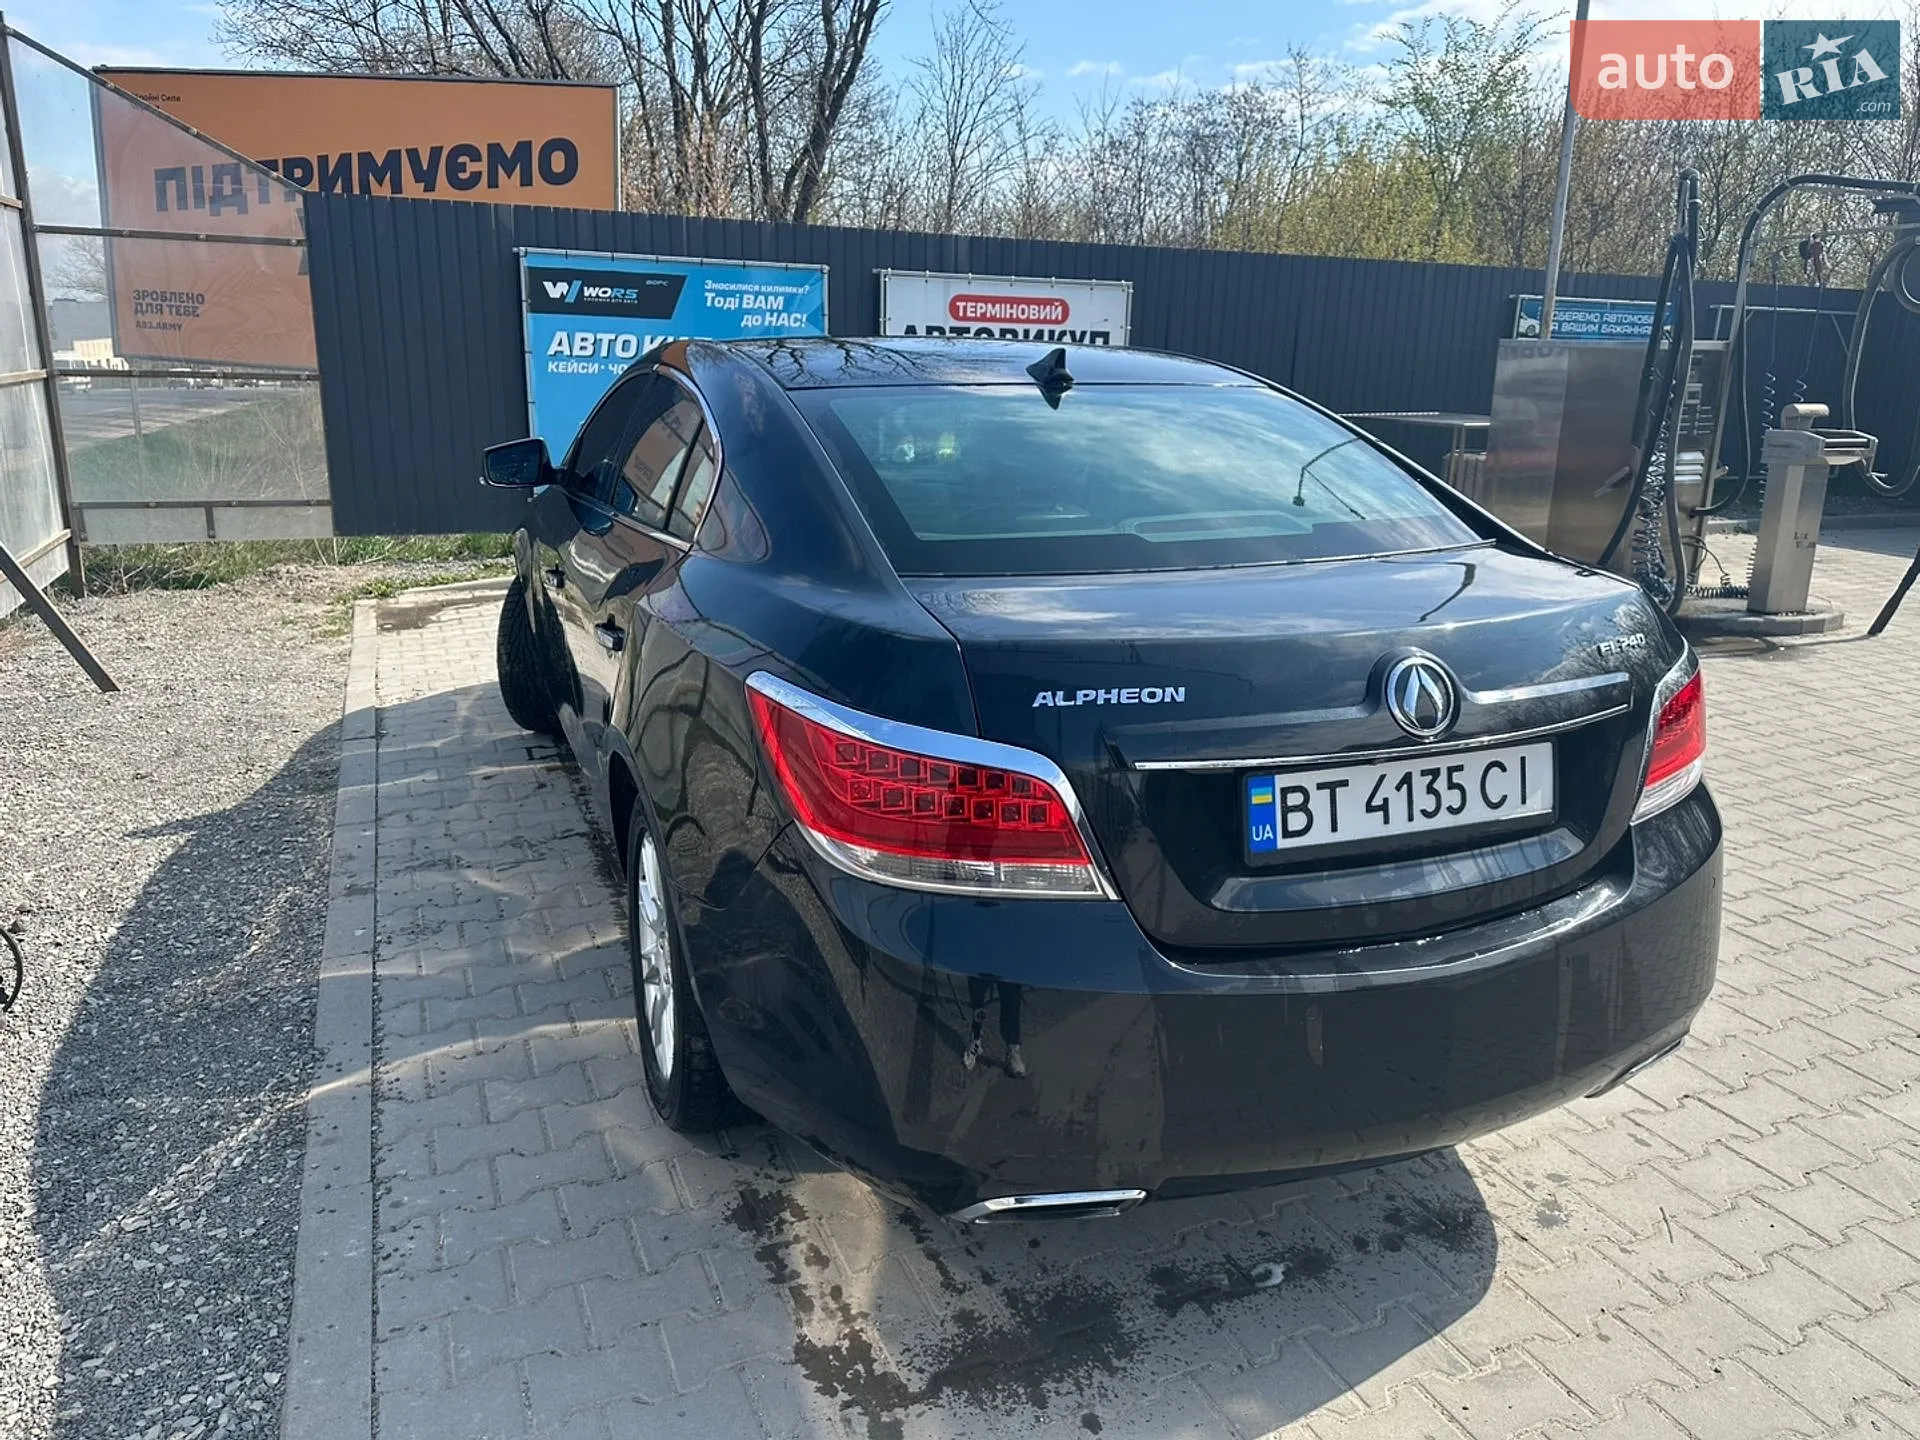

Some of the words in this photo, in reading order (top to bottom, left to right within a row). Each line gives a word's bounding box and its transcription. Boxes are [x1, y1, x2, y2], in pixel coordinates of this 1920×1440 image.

[153, 137, 579, 217] ПІДТРИМУЄМО
[583, 286, 639, 299] WORS
[704, 280, 760, 292] Зносилися
[761, 285, 810, 294] килимки?
[133, 289, 205, 305] ЗРОБЛЕНО
[704, 292, 739, 310] Тоді
[742, 294, 785, 310] ВАМ
[134, 302, 164, 316] ДЛЯ
[166, 304, 200, 317] ТЕБЕ
[956, 301, 1063, 321] ТЕРМІНОВИЙ
[741, 313, 762, 328] до
[764, 312, 807, 327] НАС!
[547, 331, 638, 358] АВТО
[547, 359, 599, 373] КЕЙСИ
[1031, 686, 1186, 708] ALPHEON
[1279, 779, 1350, 840] BT
[1365, 764, 1467, 825] 4135
[1480, 755, 1527, 810] CI
[1252, 824, 1274, 842] UA
